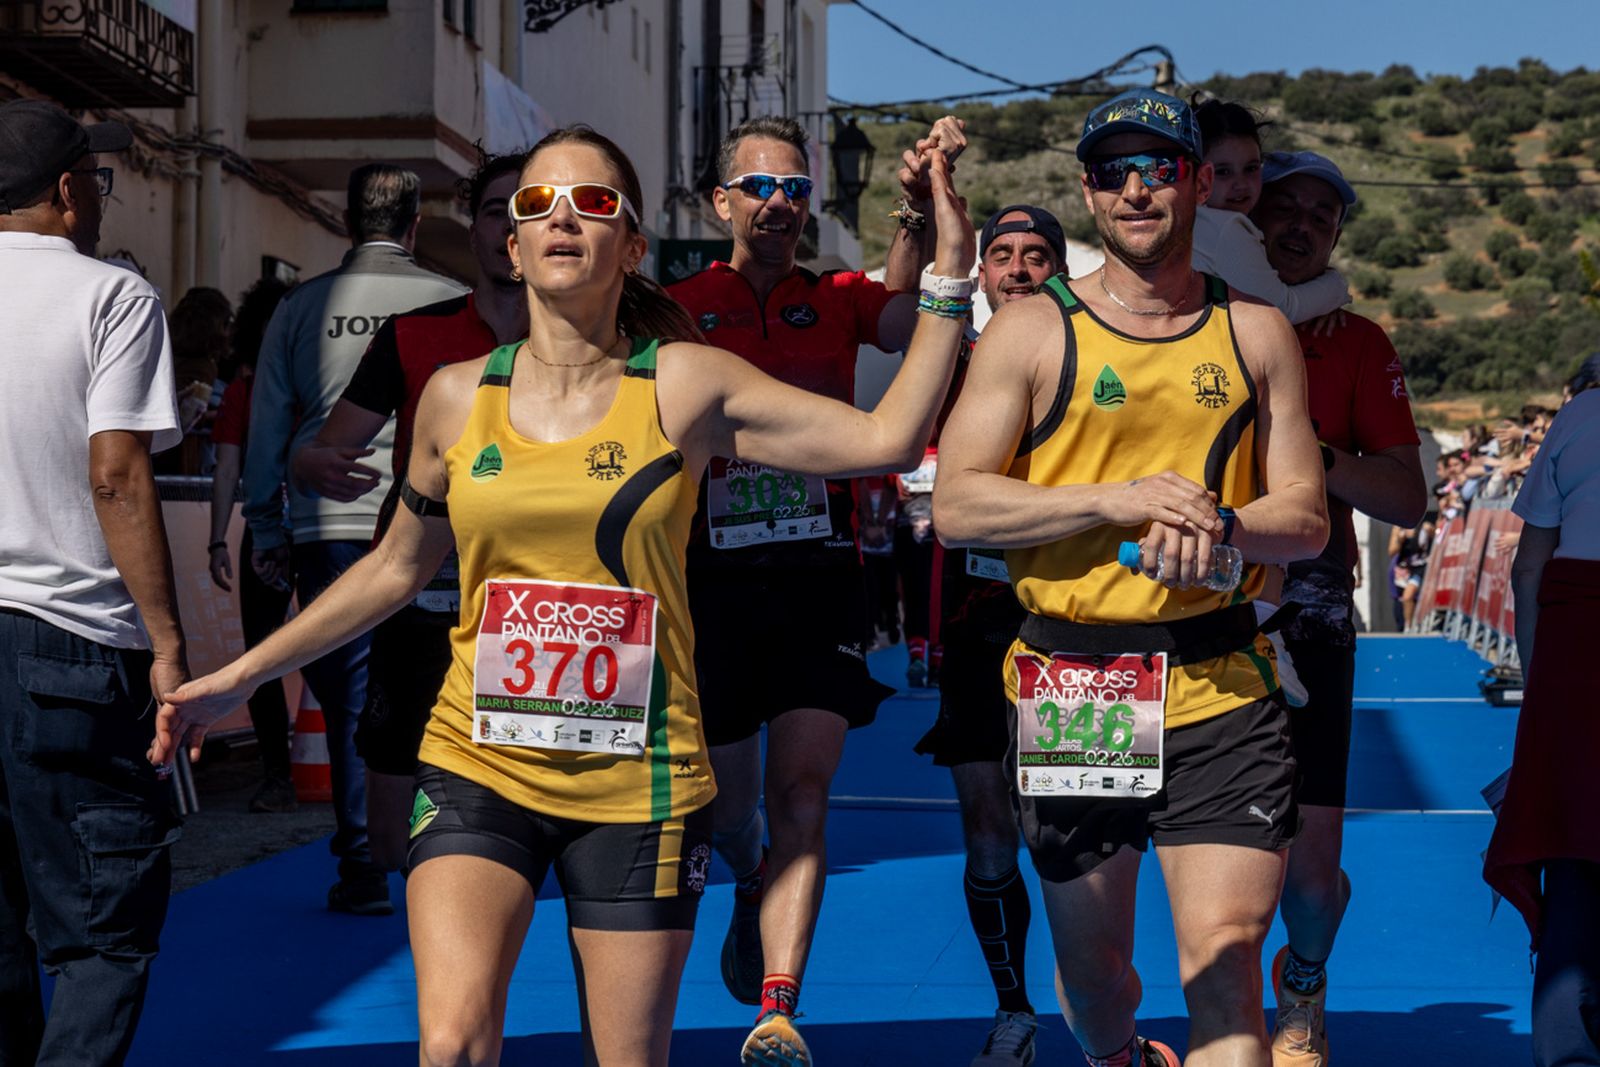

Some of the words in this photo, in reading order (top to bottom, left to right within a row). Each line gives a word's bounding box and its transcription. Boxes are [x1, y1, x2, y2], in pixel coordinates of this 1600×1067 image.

[503, 590, 531, 621] X
[533, 600, 626, 629] CROSS
[501, 621, 603, 647] PANTANO
[502, 639, 619, 701] 370
[1032, 660, 1055, 686] X
[1059, 668, 1138, 689] CROSS
[476, 697, 511, 710] MARIA
[1034, 687, 1119, 706] PANTANO
[1035, 701, 1136, 752] 346
[1019, 753, 1049, 765] DANIEL
